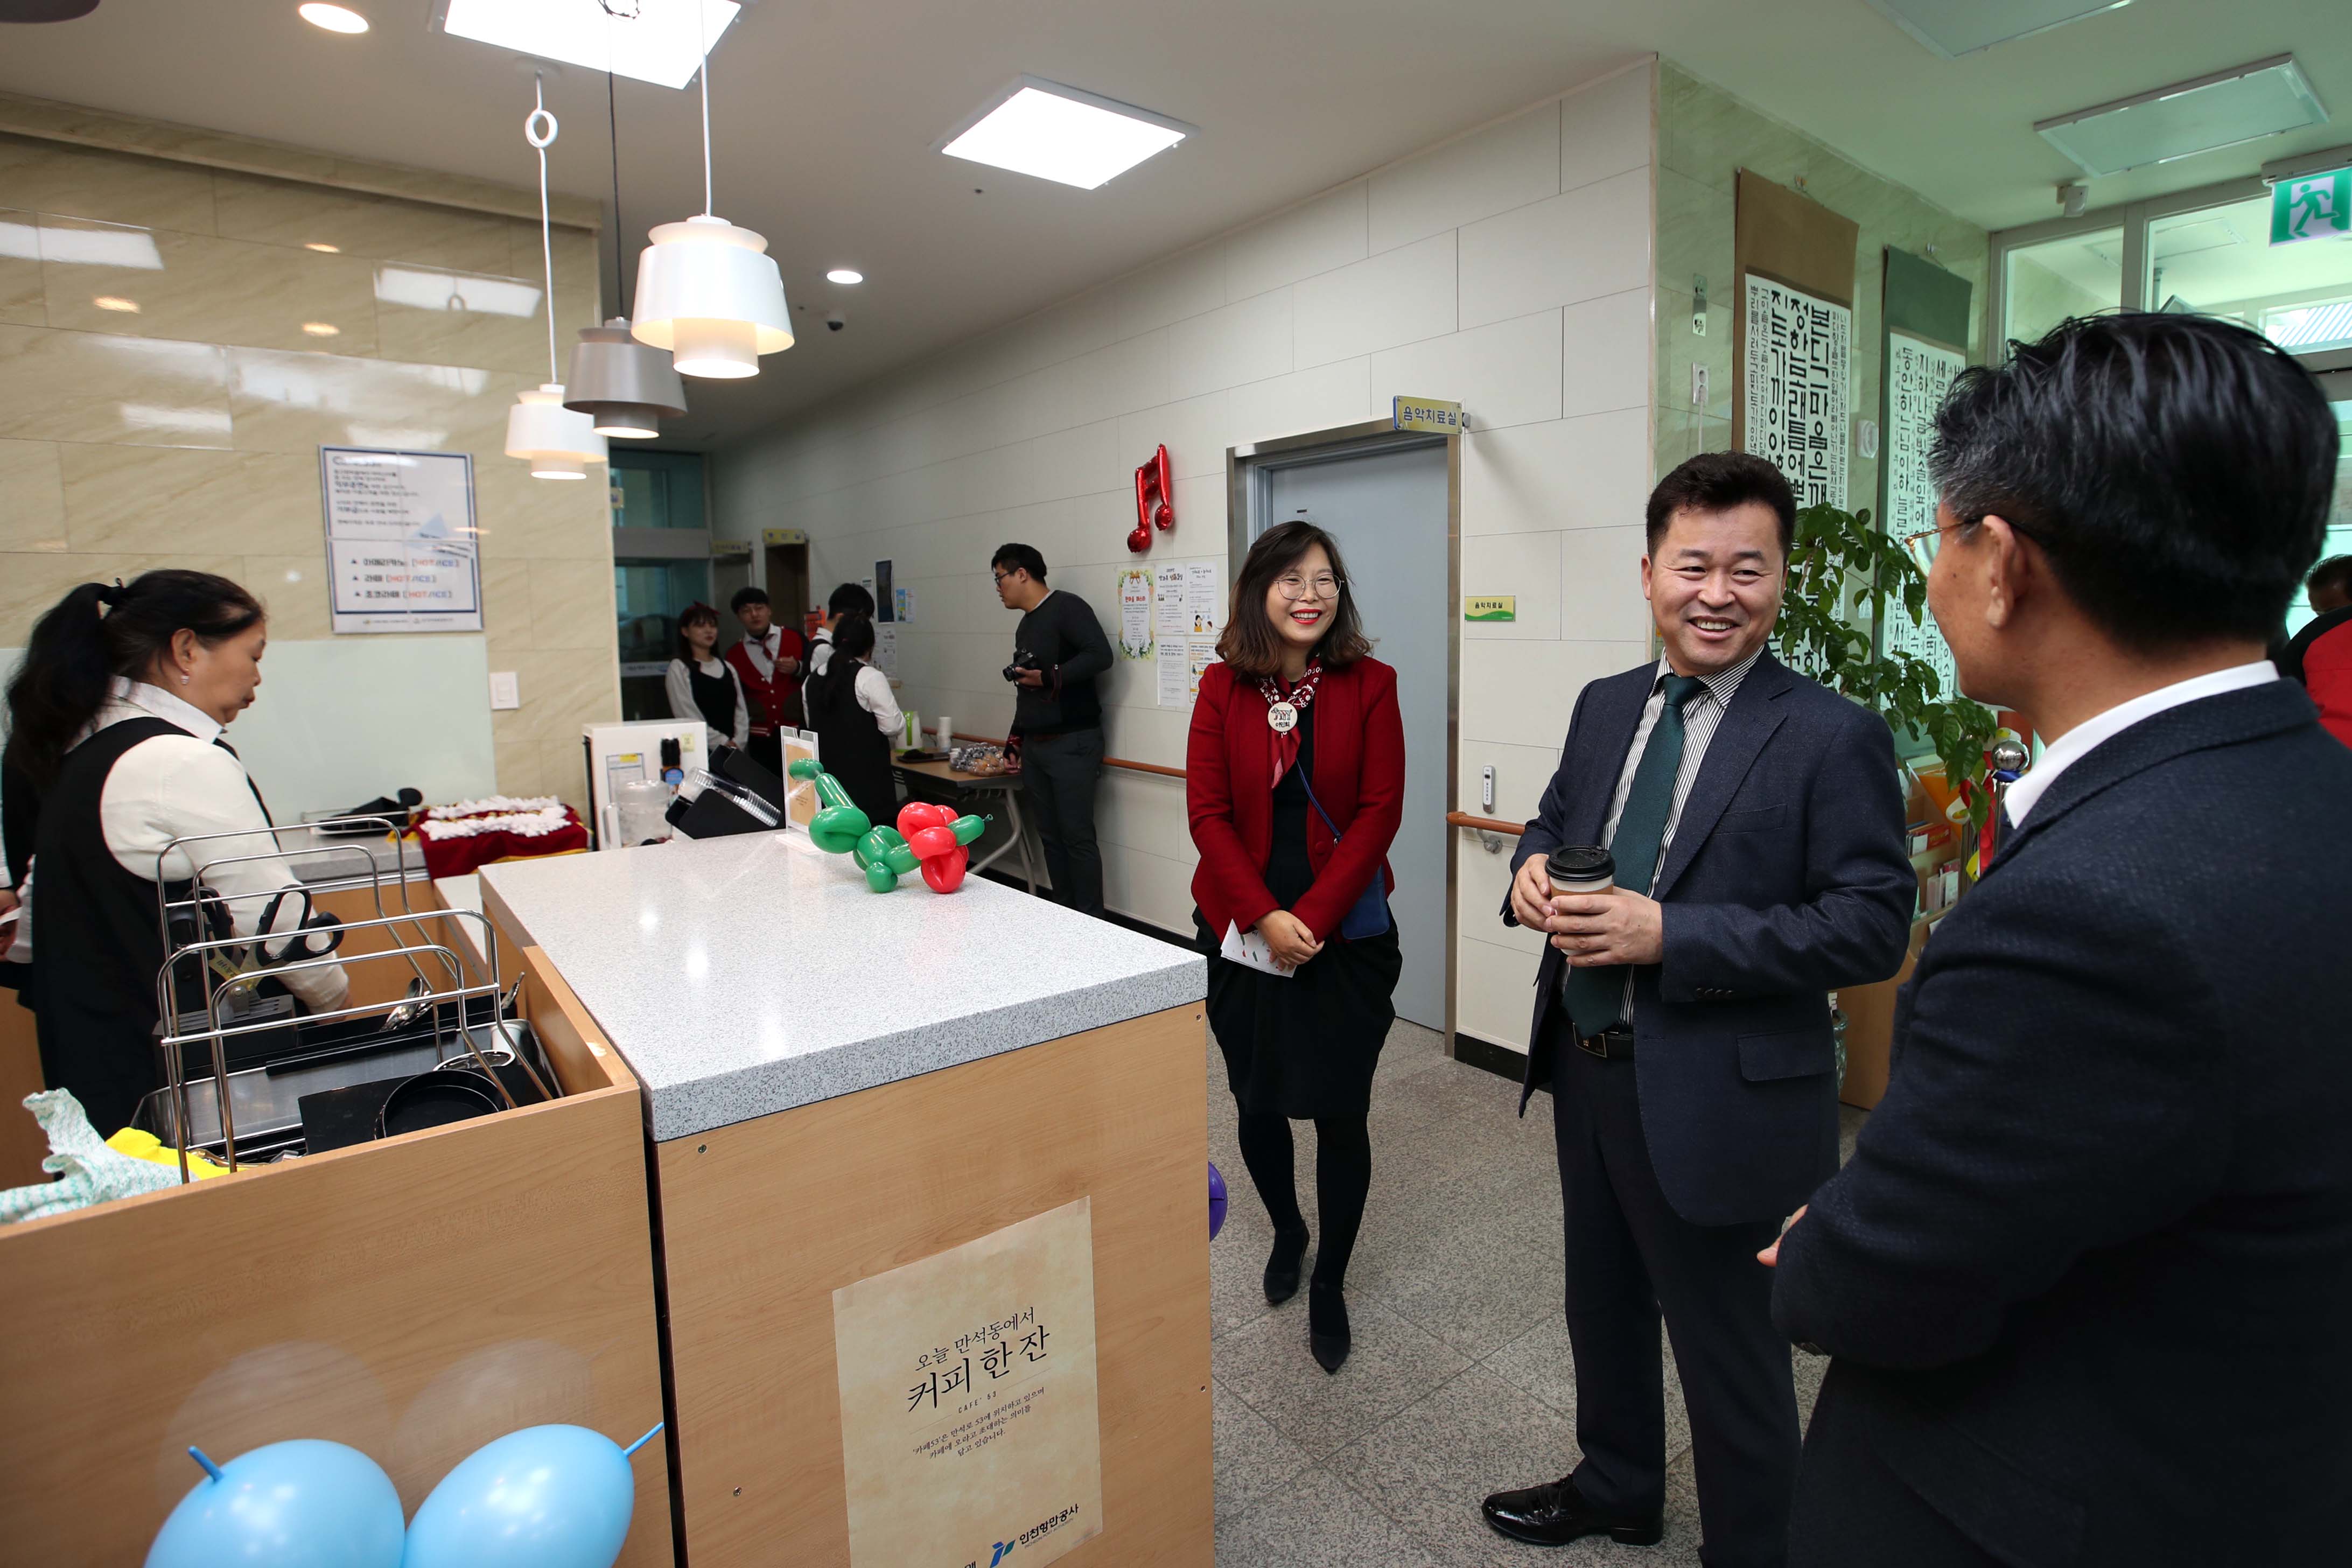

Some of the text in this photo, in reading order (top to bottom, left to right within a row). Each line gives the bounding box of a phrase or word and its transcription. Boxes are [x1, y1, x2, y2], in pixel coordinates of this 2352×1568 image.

[1403, 406, 1457, 425] 음악치료실
[915, 1306, 1034, 1371] 오늘 만석동에서
[907, 1325, 1050, 1412] 커피 한 잔
[950, 1423, 974, 1438] 만석로
[975, 1412, 991, 1426] 53에
[993, 1399, 1022, 1418] 위치하고
[1024, 1387, 1045, 1402] 있으며
[987, 1391, 997, 1400] 53
[929, 1442, 953, 1459] 카페에
[955, 1432, 977, 1446] 오라고
[979, 1416, 1009, 1435] 초대하는
[957, 1428, 1006, 1457] 담고 있습니다.
[1019, 1503, 1079, 1545] 인천항만공사
